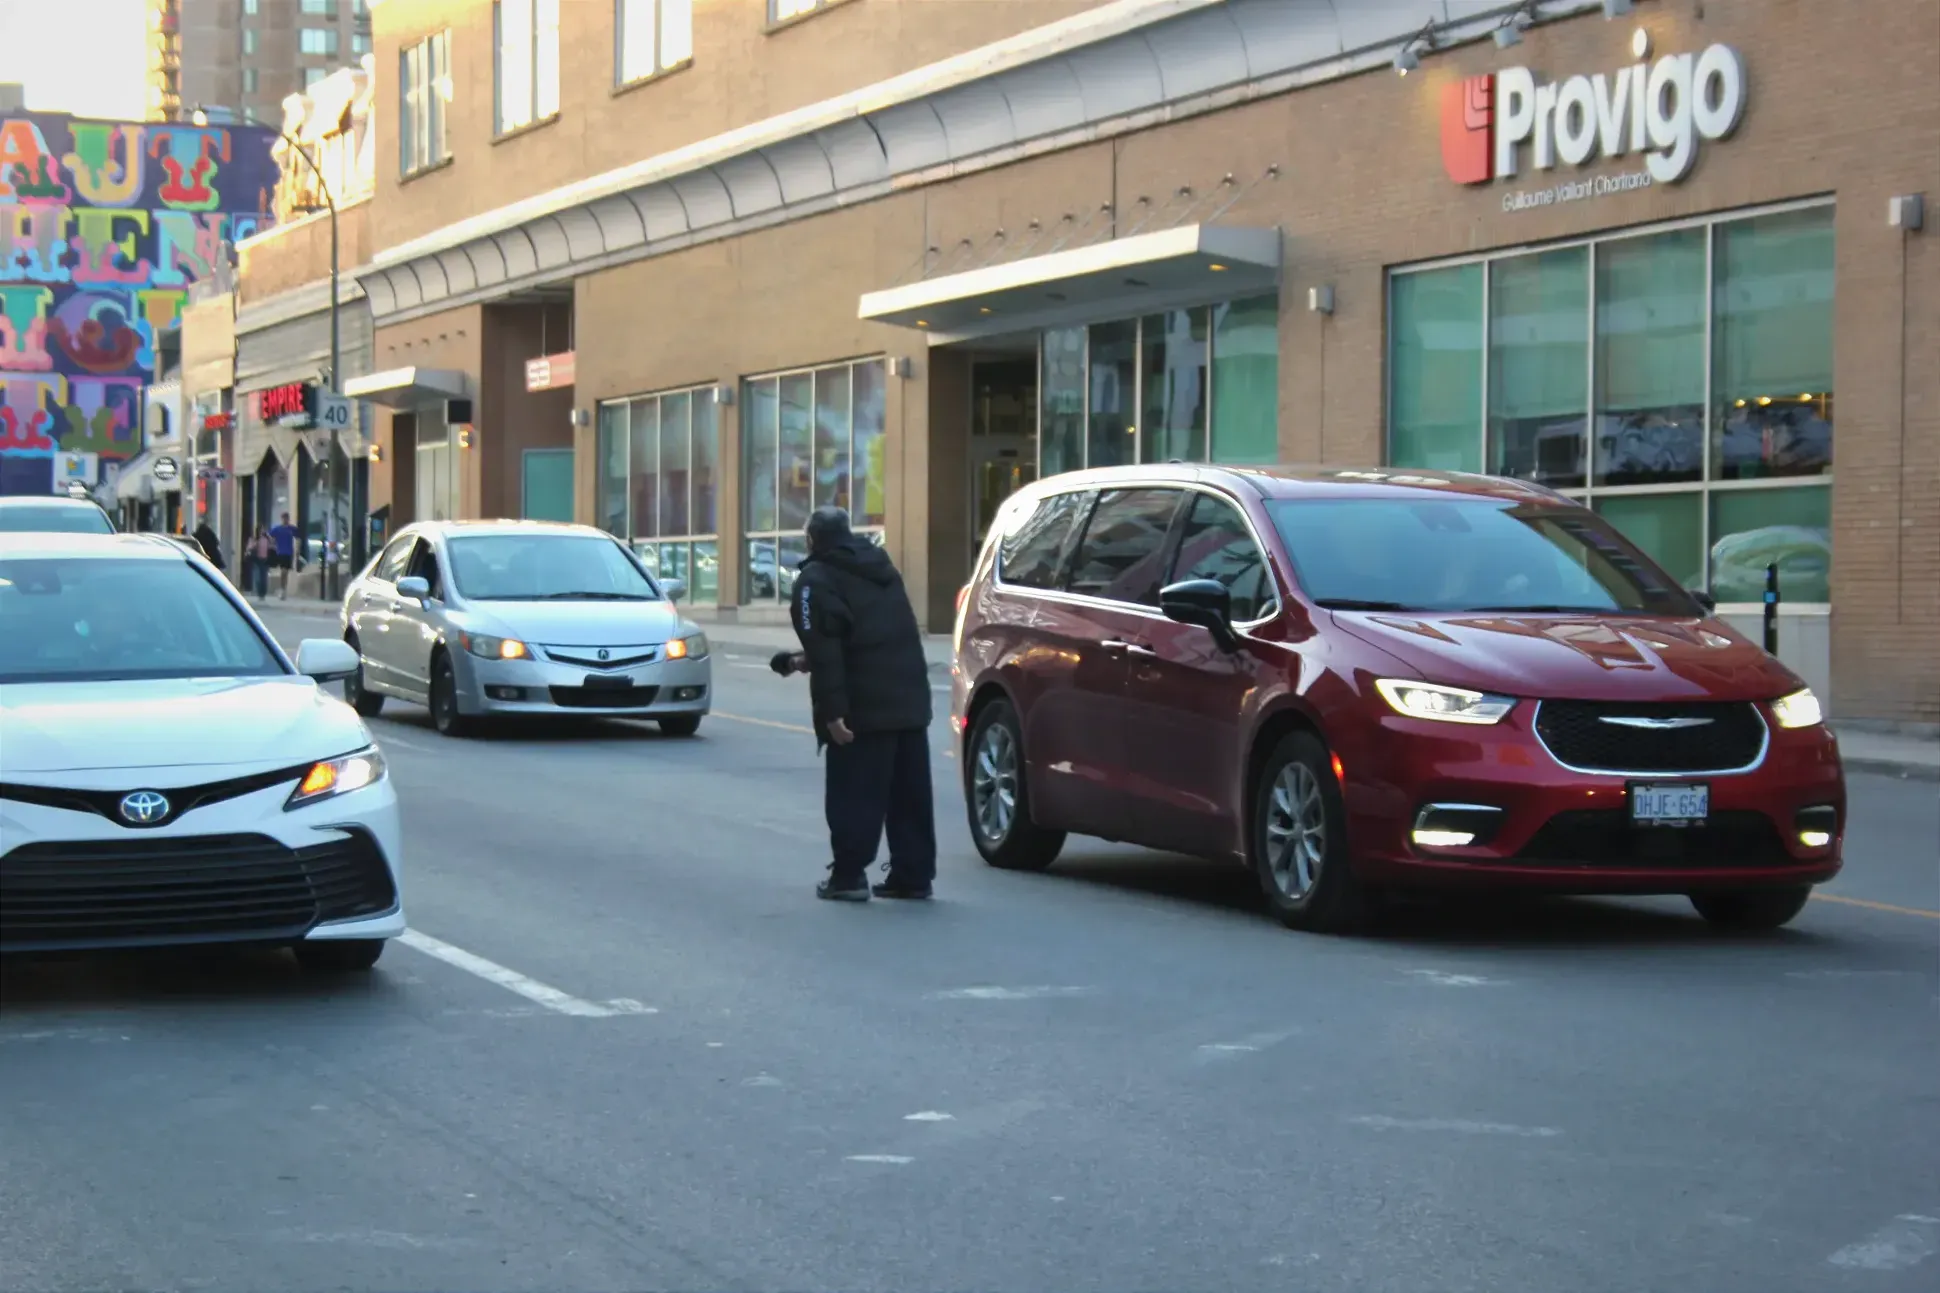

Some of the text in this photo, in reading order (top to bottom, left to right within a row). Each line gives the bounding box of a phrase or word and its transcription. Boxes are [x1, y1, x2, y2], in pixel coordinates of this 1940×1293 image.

[1496, 27, 1743, 183] Provigo
[261, 382, 304, 419] EMPIRE
[325, 404, 348, 425] 40
[1679, 794, 1707, 816] 654
